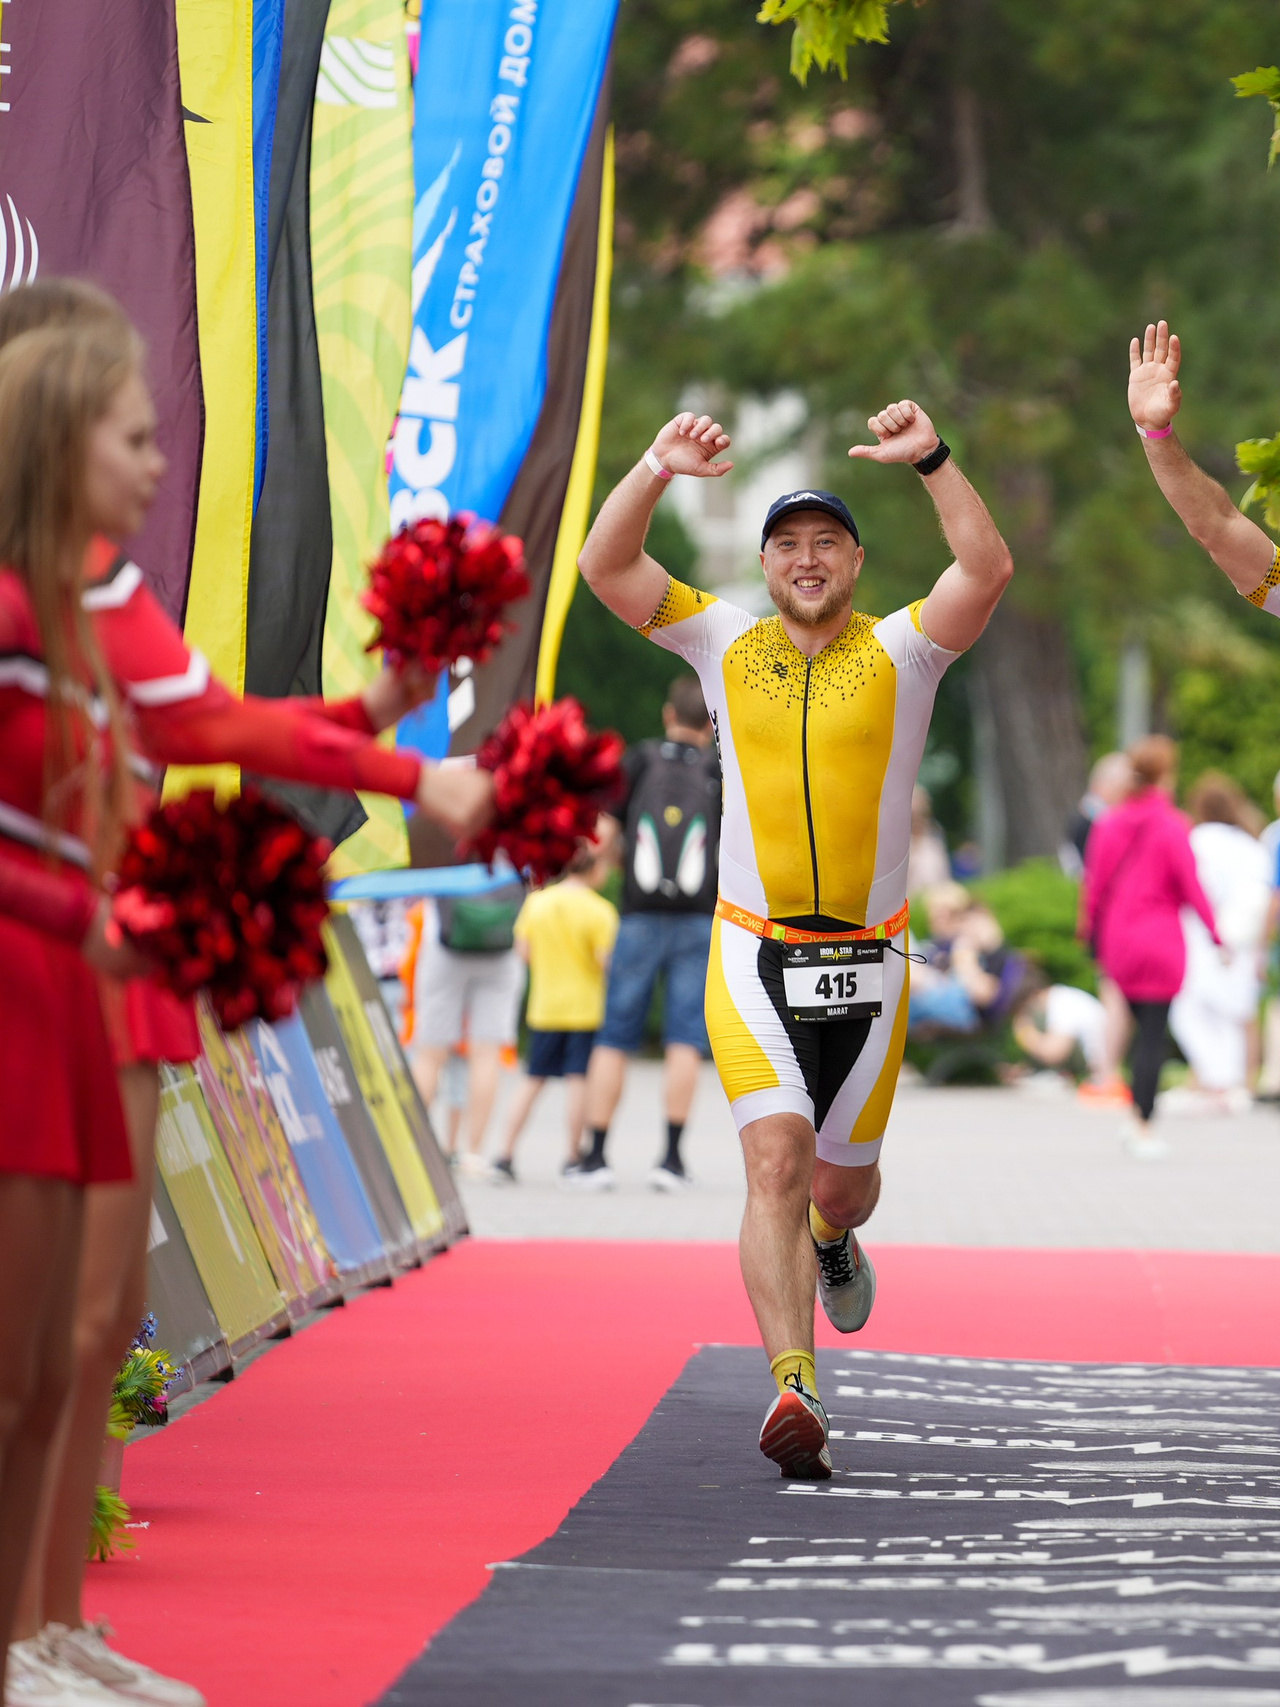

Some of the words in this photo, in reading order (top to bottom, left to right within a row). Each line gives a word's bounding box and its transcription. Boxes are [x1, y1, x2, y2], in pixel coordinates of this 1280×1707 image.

[450, 92, 520, 330] СТРАХОВОЙ
[498, 0, 537, 88] ДОМ
[820, 947, 834, 956] IRON
[839, 946, 853, 955] STAR
[815, 971, 858, 1000] 415
[827, 1006, 849, 1016] MARAT
[786, 1483, 1070, 1499] IRON
